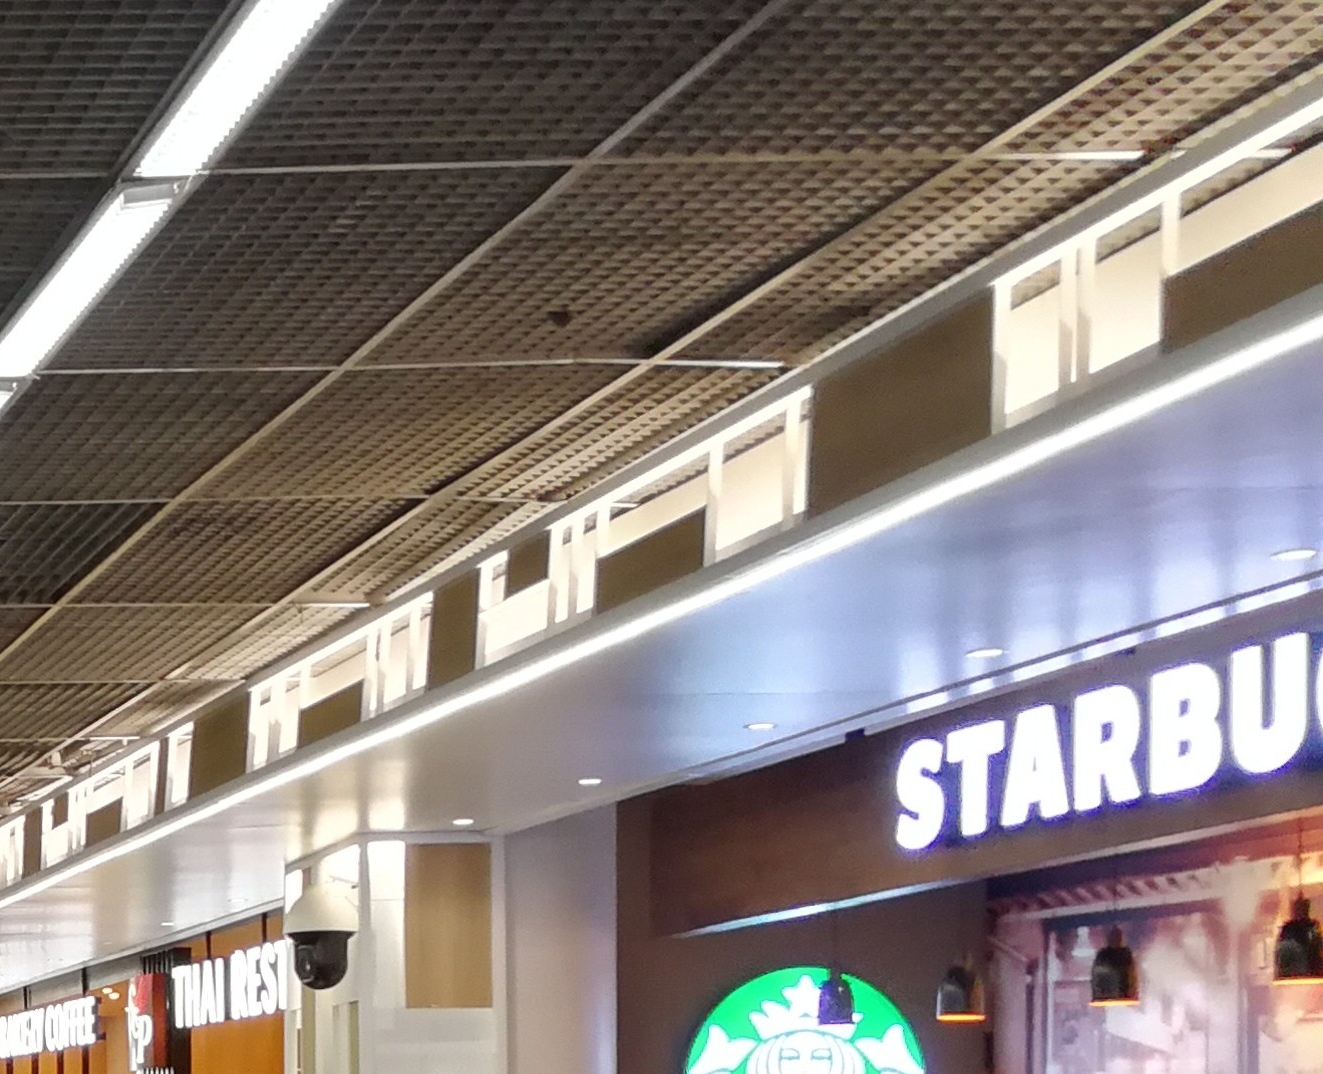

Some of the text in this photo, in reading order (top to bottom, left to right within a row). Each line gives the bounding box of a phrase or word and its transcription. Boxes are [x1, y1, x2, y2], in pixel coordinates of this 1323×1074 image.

[894, 631, 1323, 852] STARBU
[45, 995, 98, 1052] COFFEE
[171, 957, 225, 1029] THAI
